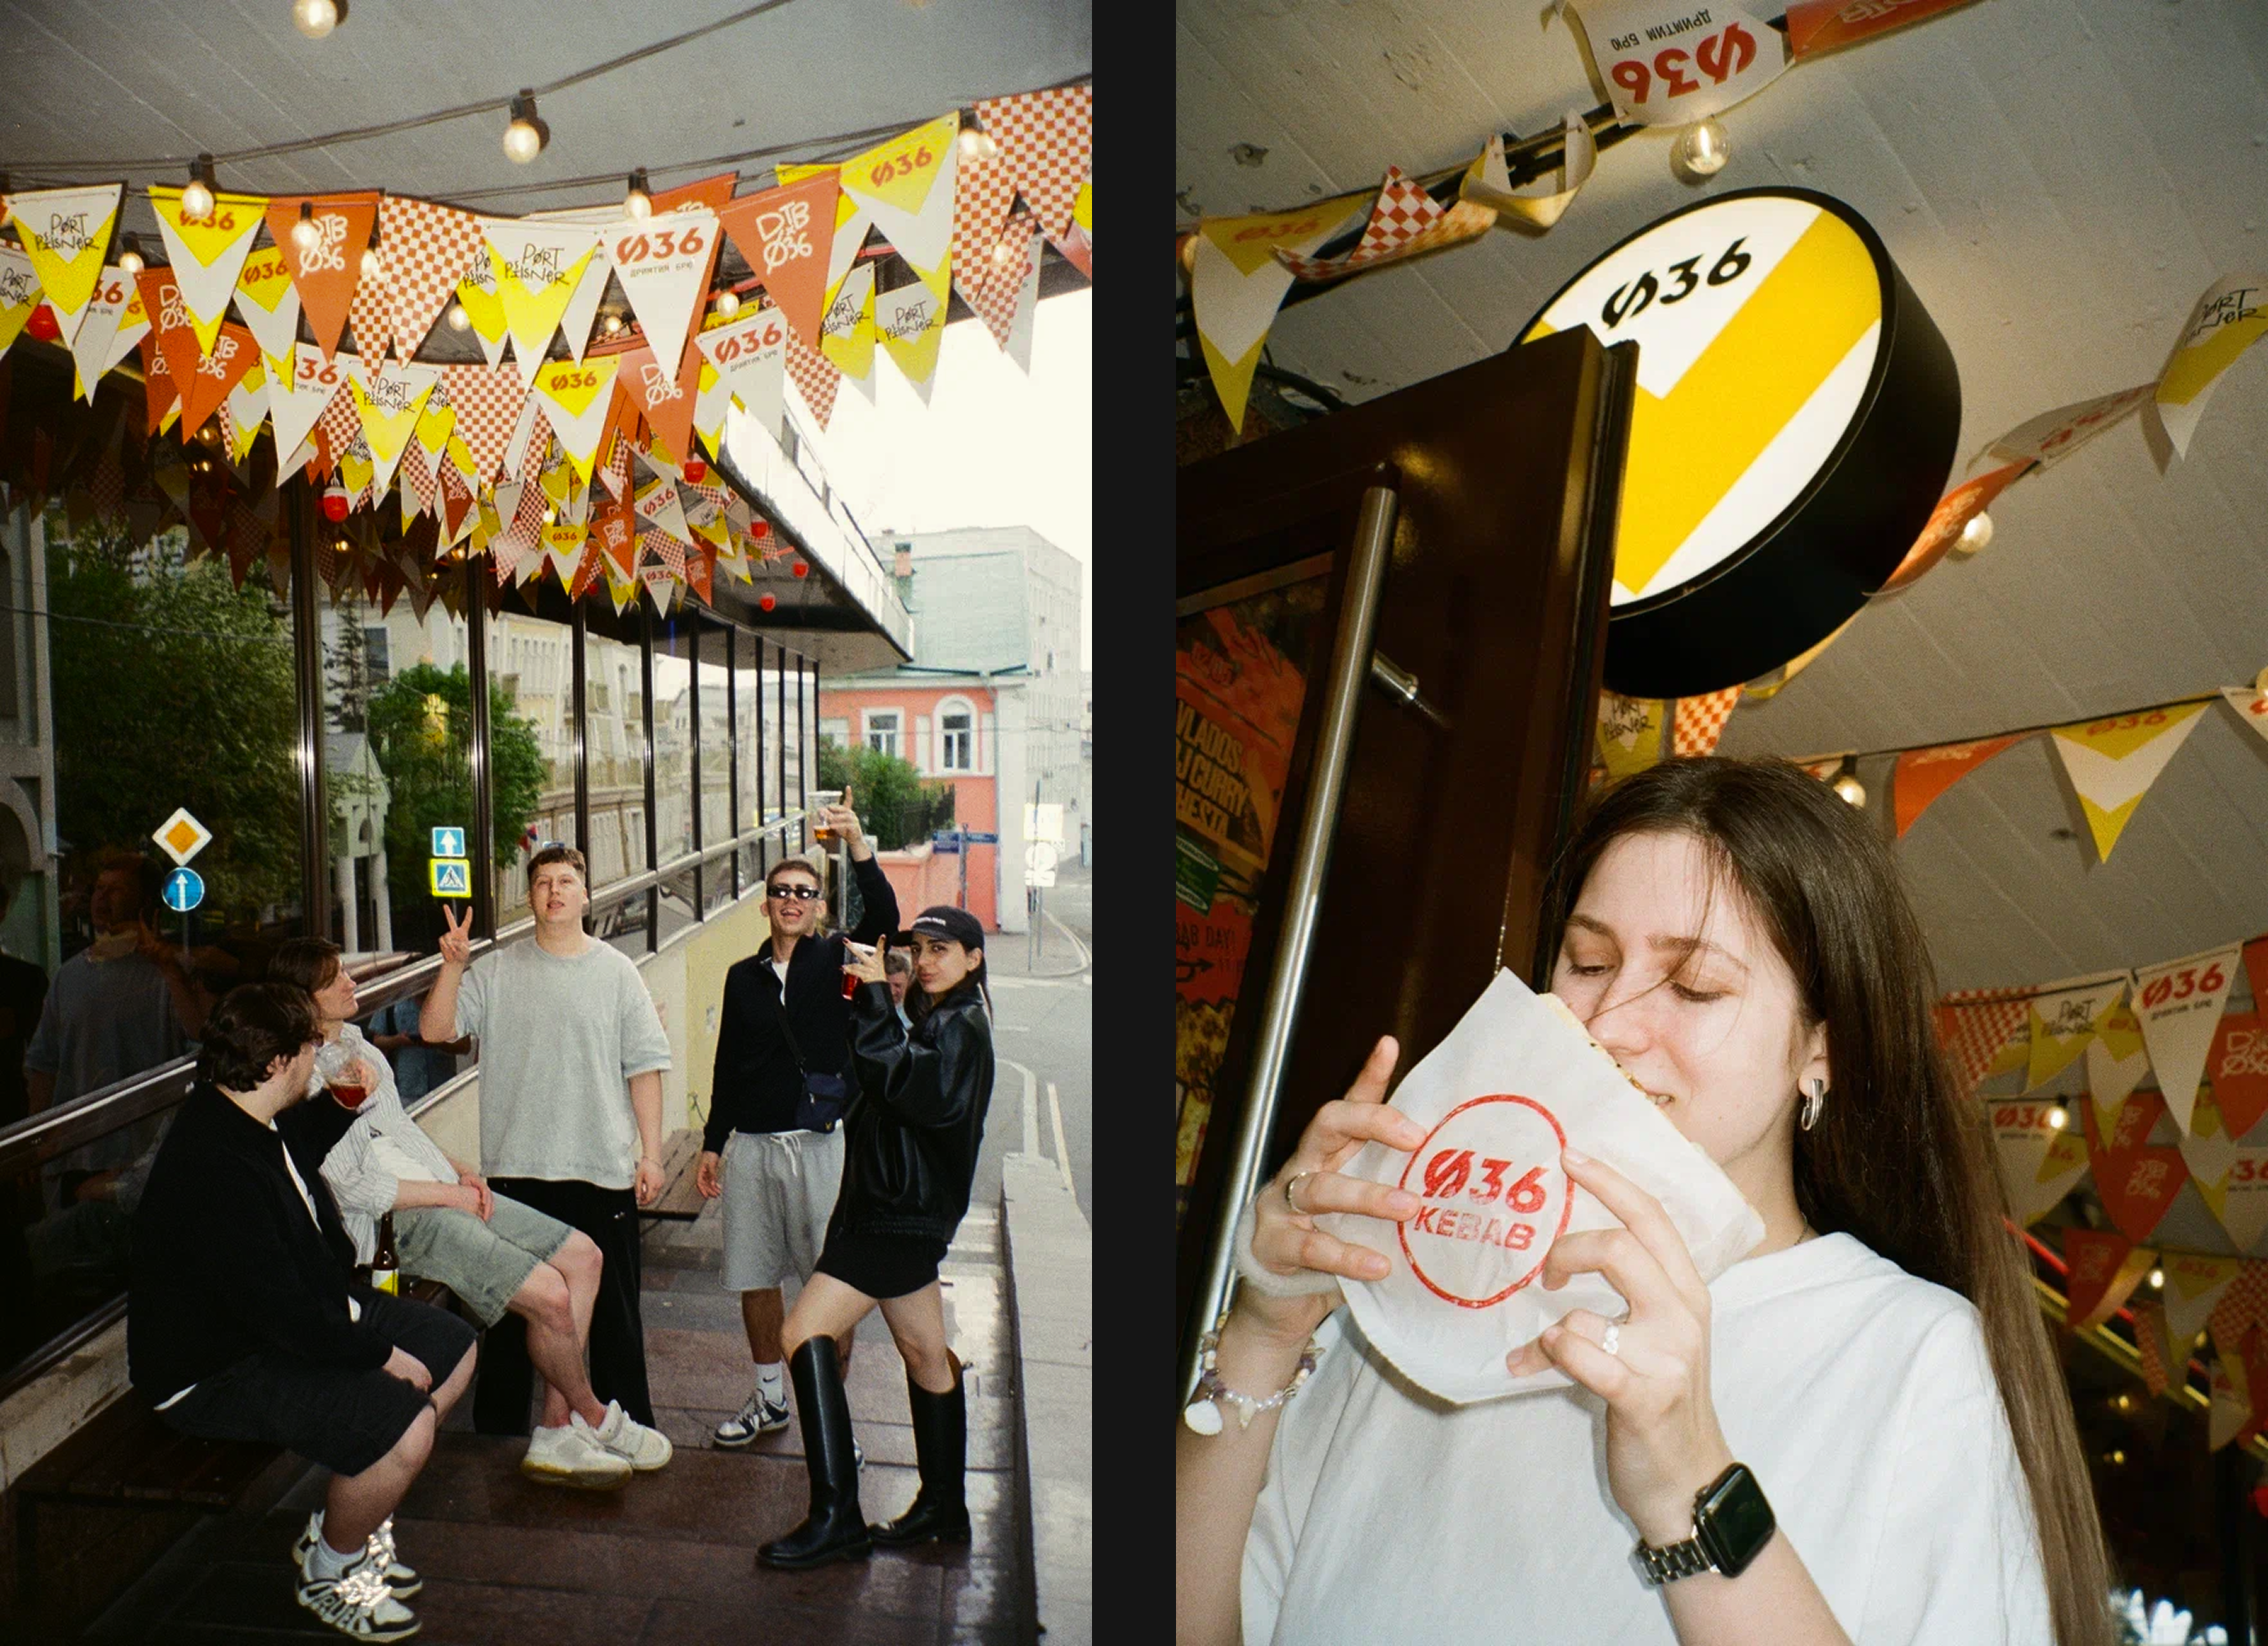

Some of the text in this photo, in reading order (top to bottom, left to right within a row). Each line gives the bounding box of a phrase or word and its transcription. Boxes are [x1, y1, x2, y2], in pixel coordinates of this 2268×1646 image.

[1610, 8, 1713, 51] ДРИМТИМ БРЮ
[1611, 22, 1756, 103] Ø36
[870, 146, 932, 187] Ø36
[616, 226, 704, 265] Ø36
[1601, 235, 1751, 329] Ø36
[715, 322, 782, 364] Ø36
[296, 356, 338, 385] 36
[550, 371, 597, 391] Ø36
[2142, 962, 2224, 1009] Ø36
[1422, 1148, 1550, 1214] Ø36
[1414, 1204, 1536, 1251] KEBAB
